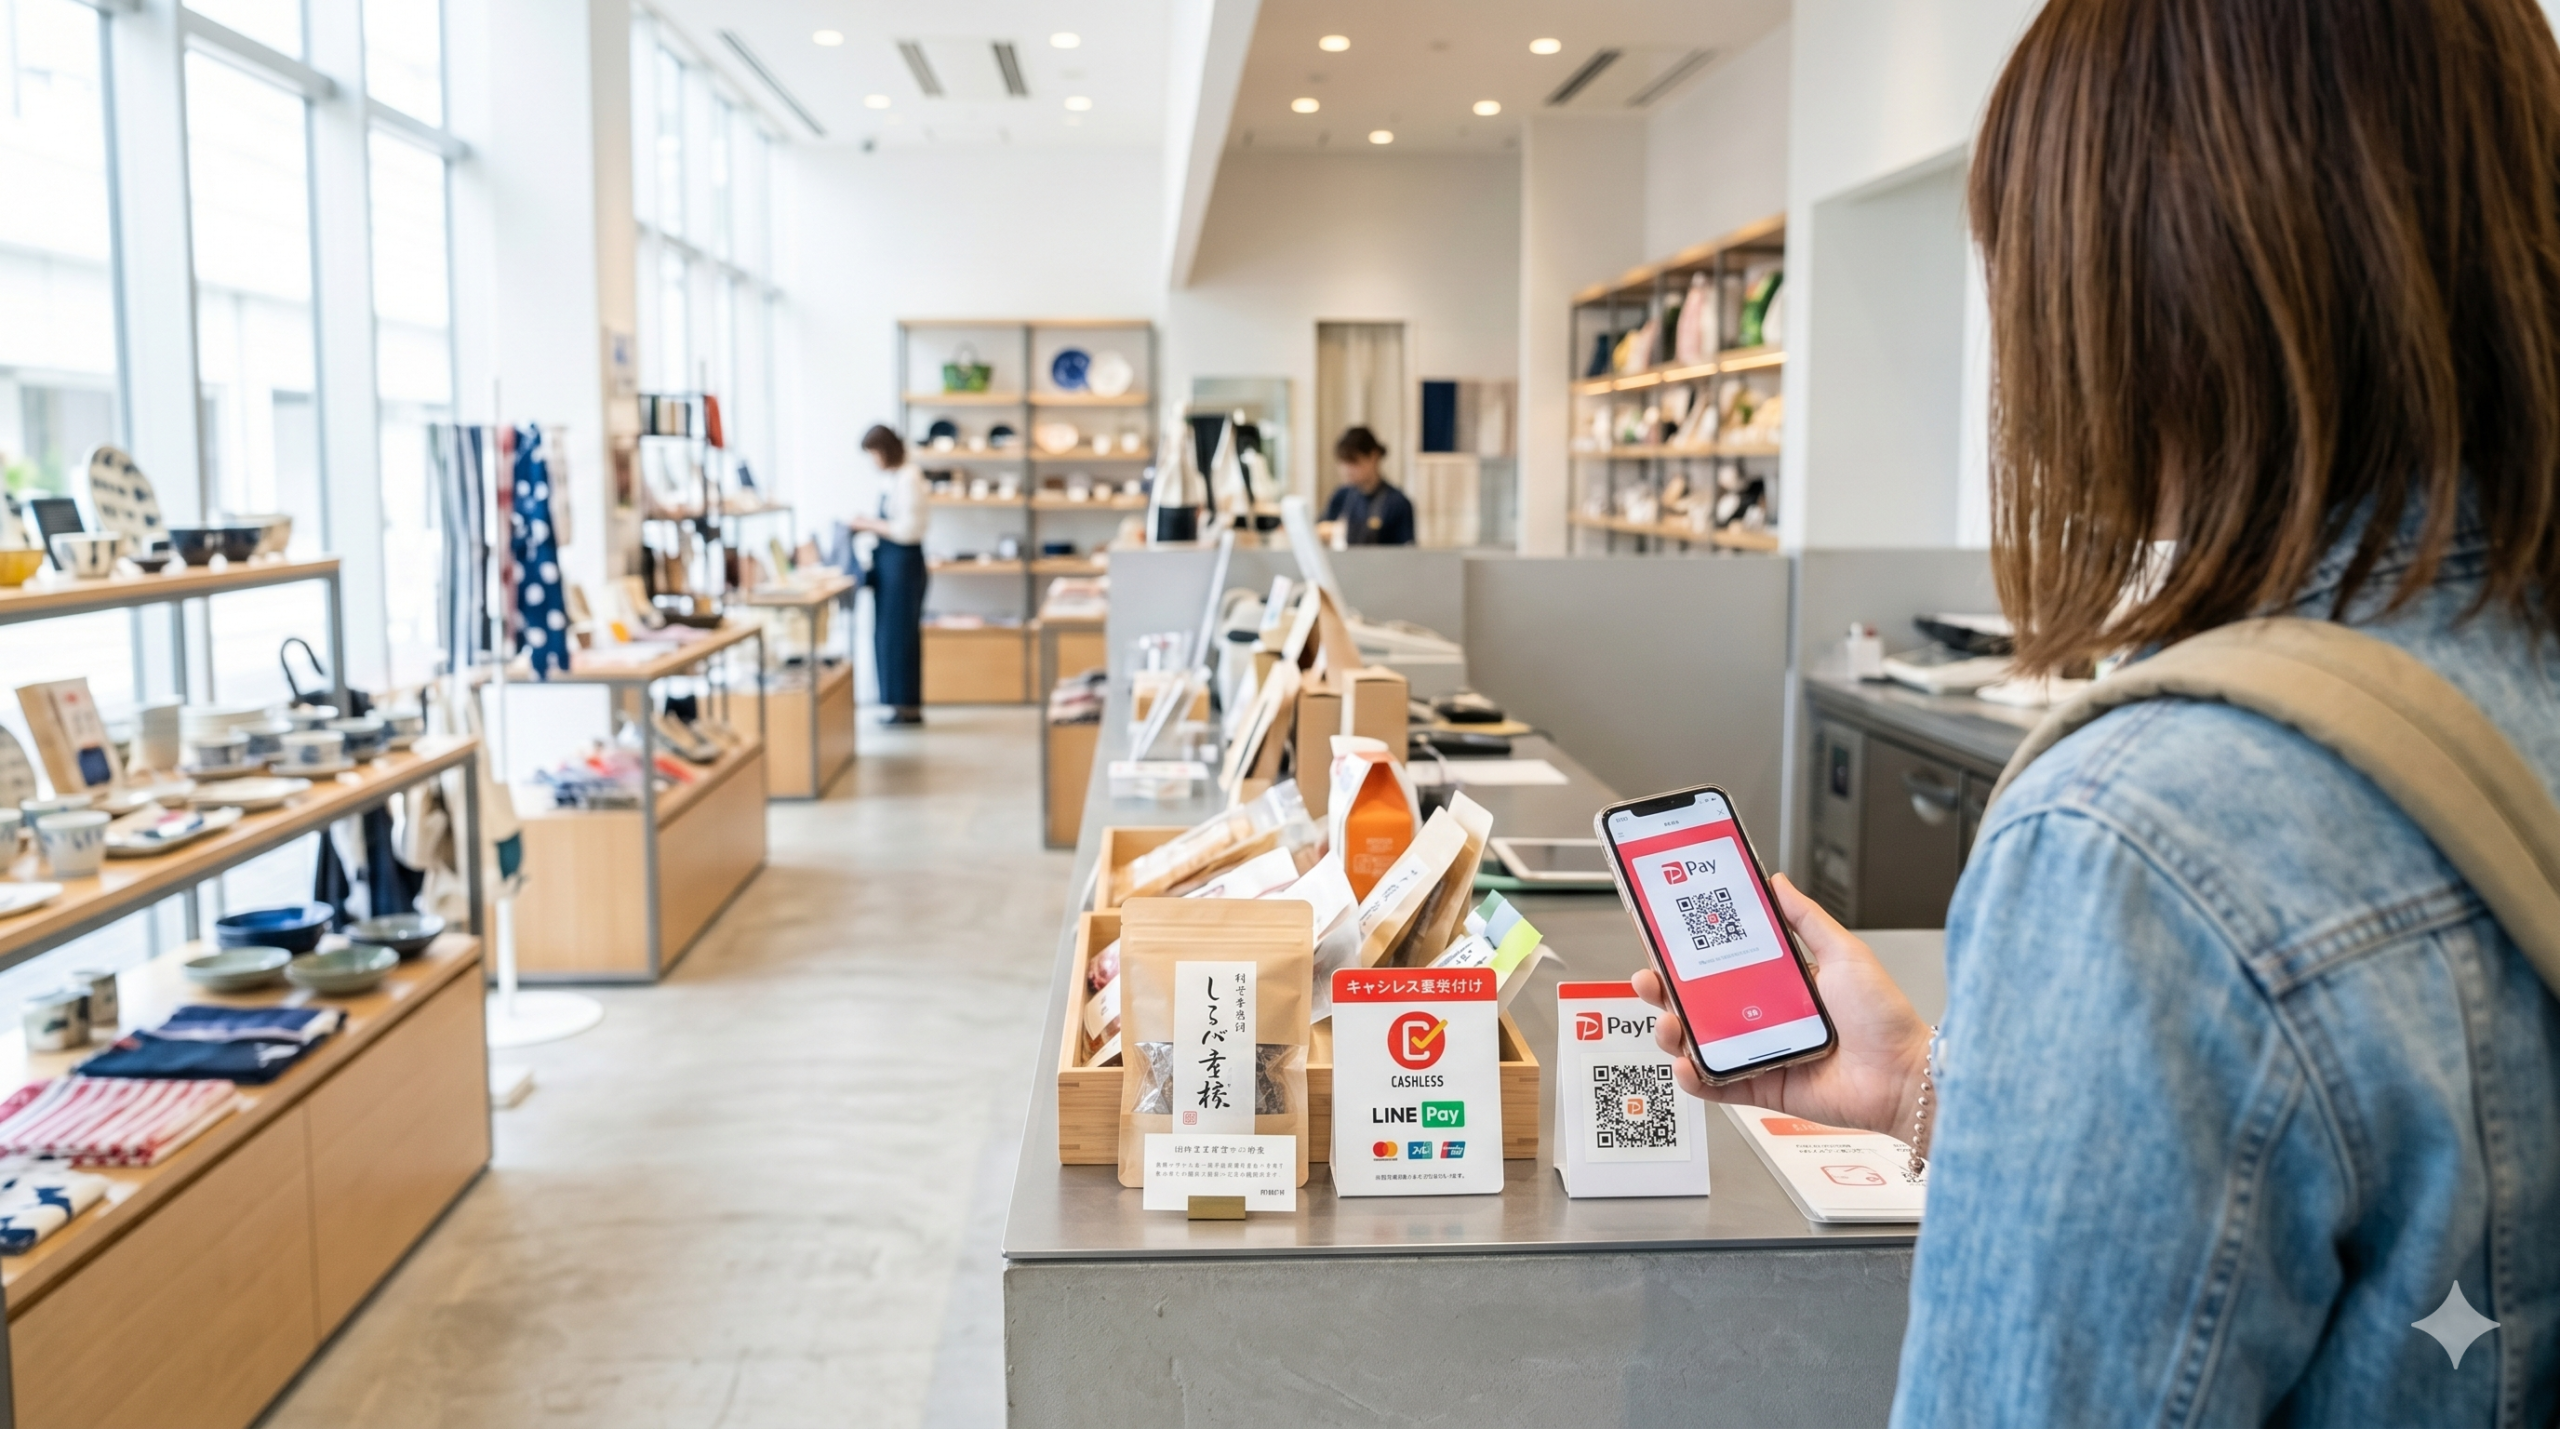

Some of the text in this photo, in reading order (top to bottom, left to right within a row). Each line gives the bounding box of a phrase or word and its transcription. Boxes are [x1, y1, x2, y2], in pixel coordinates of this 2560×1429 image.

[1685, 858, 1717, 876] Pay
[1391, 1075, 1444, 1088] CASHLESS
[1372, 1106, 1460, 1125] LINE Pay
